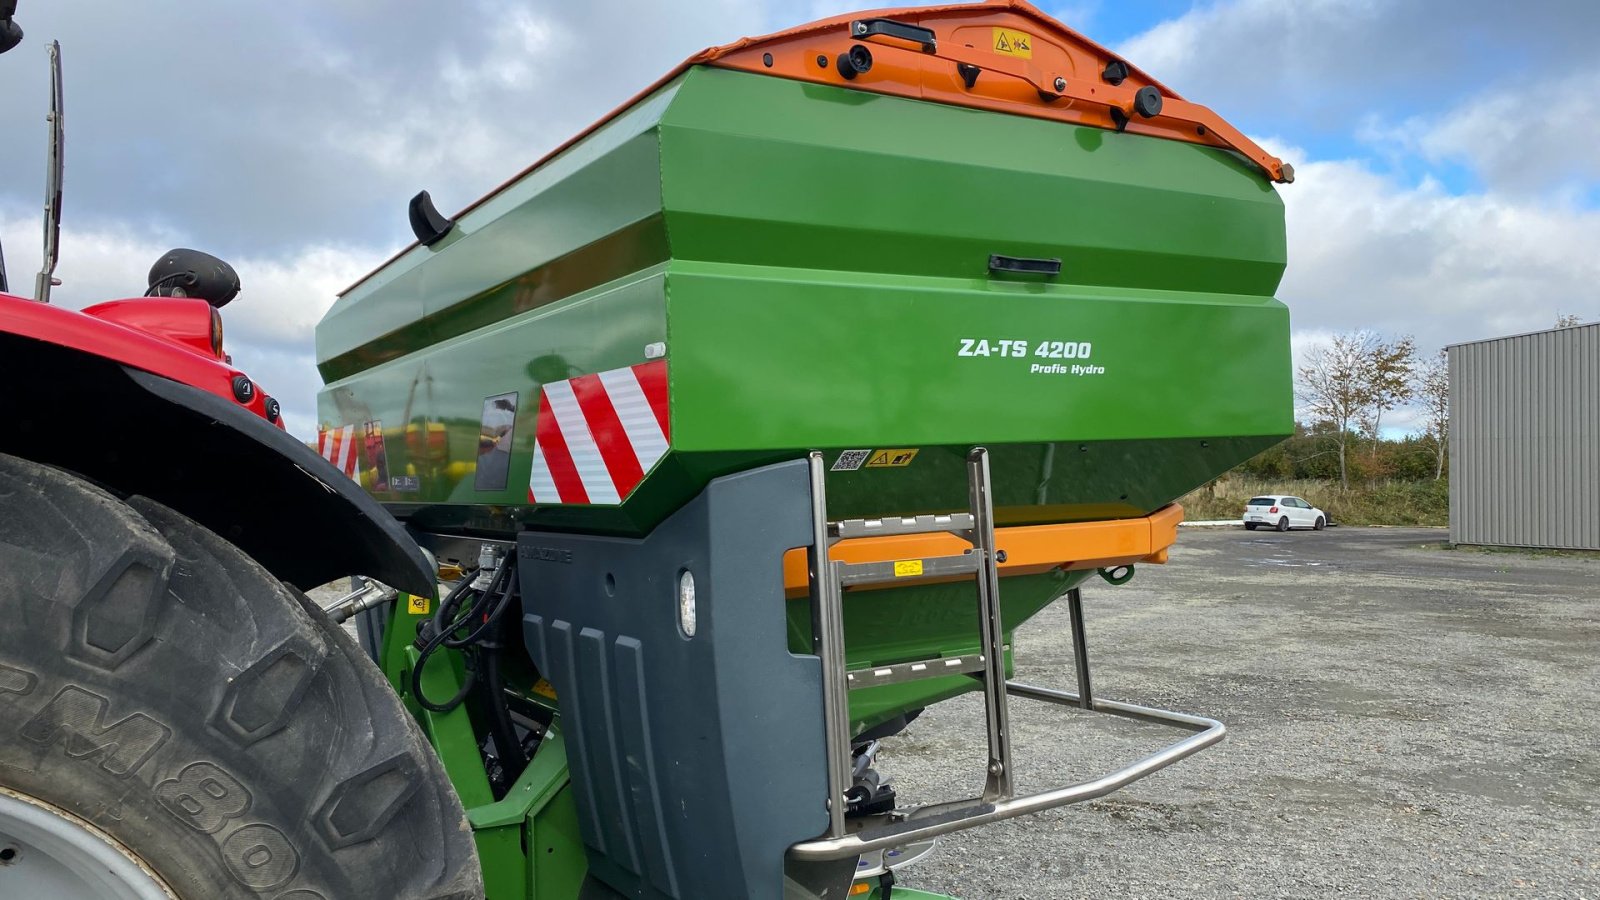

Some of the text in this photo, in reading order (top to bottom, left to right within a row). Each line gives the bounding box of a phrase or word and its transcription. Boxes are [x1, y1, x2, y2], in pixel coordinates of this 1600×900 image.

[958, 338, 1092, 359] ZA-TS 4200
[1030, 363, 1105, 376] Profis Hydro
